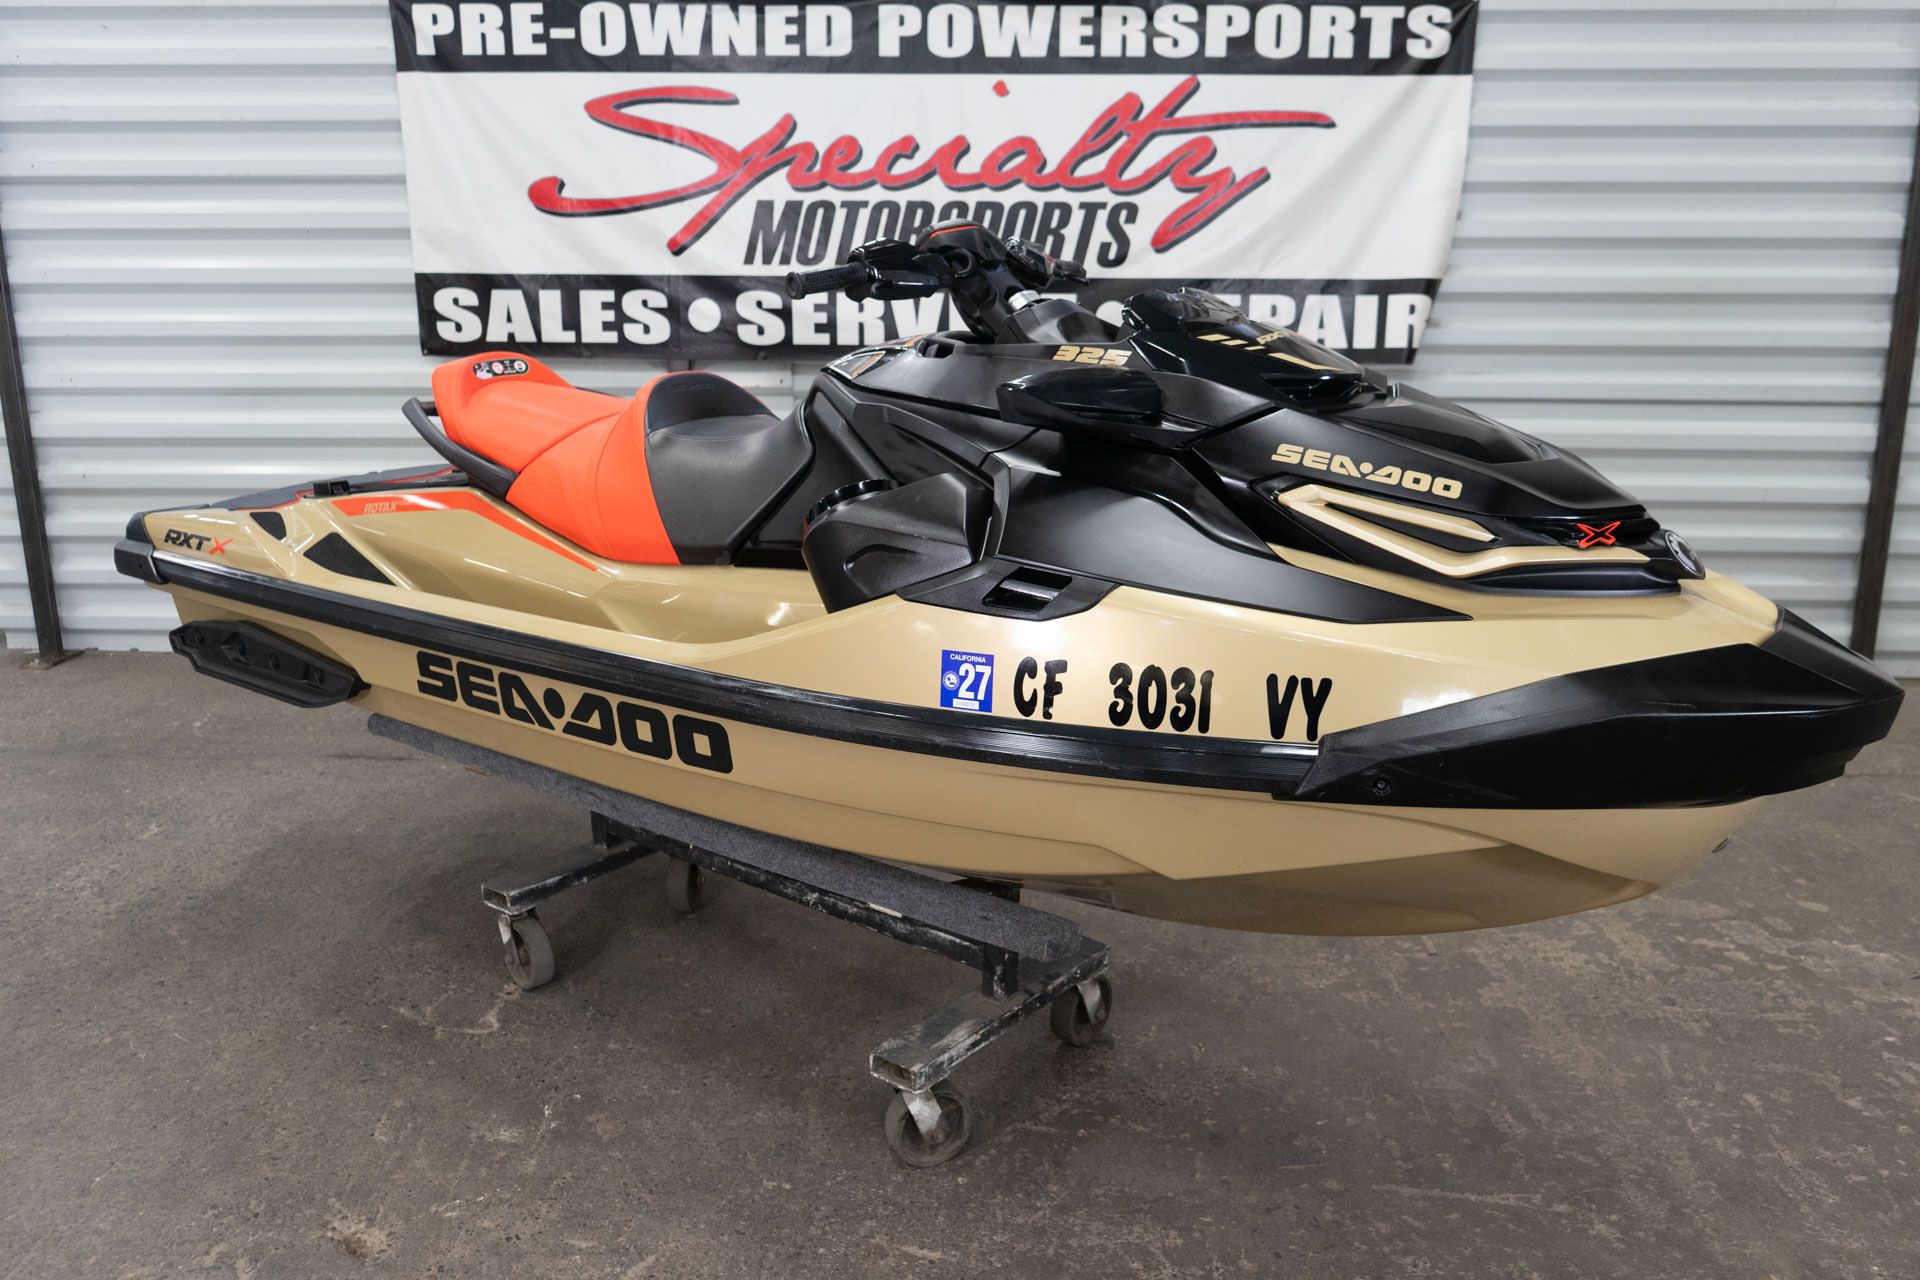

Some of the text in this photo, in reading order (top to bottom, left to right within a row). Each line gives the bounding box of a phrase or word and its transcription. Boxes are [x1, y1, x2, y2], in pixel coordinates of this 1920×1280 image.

[412, 2, 1453, 60] PRE-OWNED POWERSPORTS
[528, 75, 1337, 257] Specialty
[433, 287, 673, 346] SALES
[1052, 345, 1132, 369] 325
[363, 500, 397, 514] ROTAX
[949, 653, 987, 664] CALIFORNIA
[957, 662, 992, 701] 27
[1013, 656, 1333, 742] CF 3031 VY
